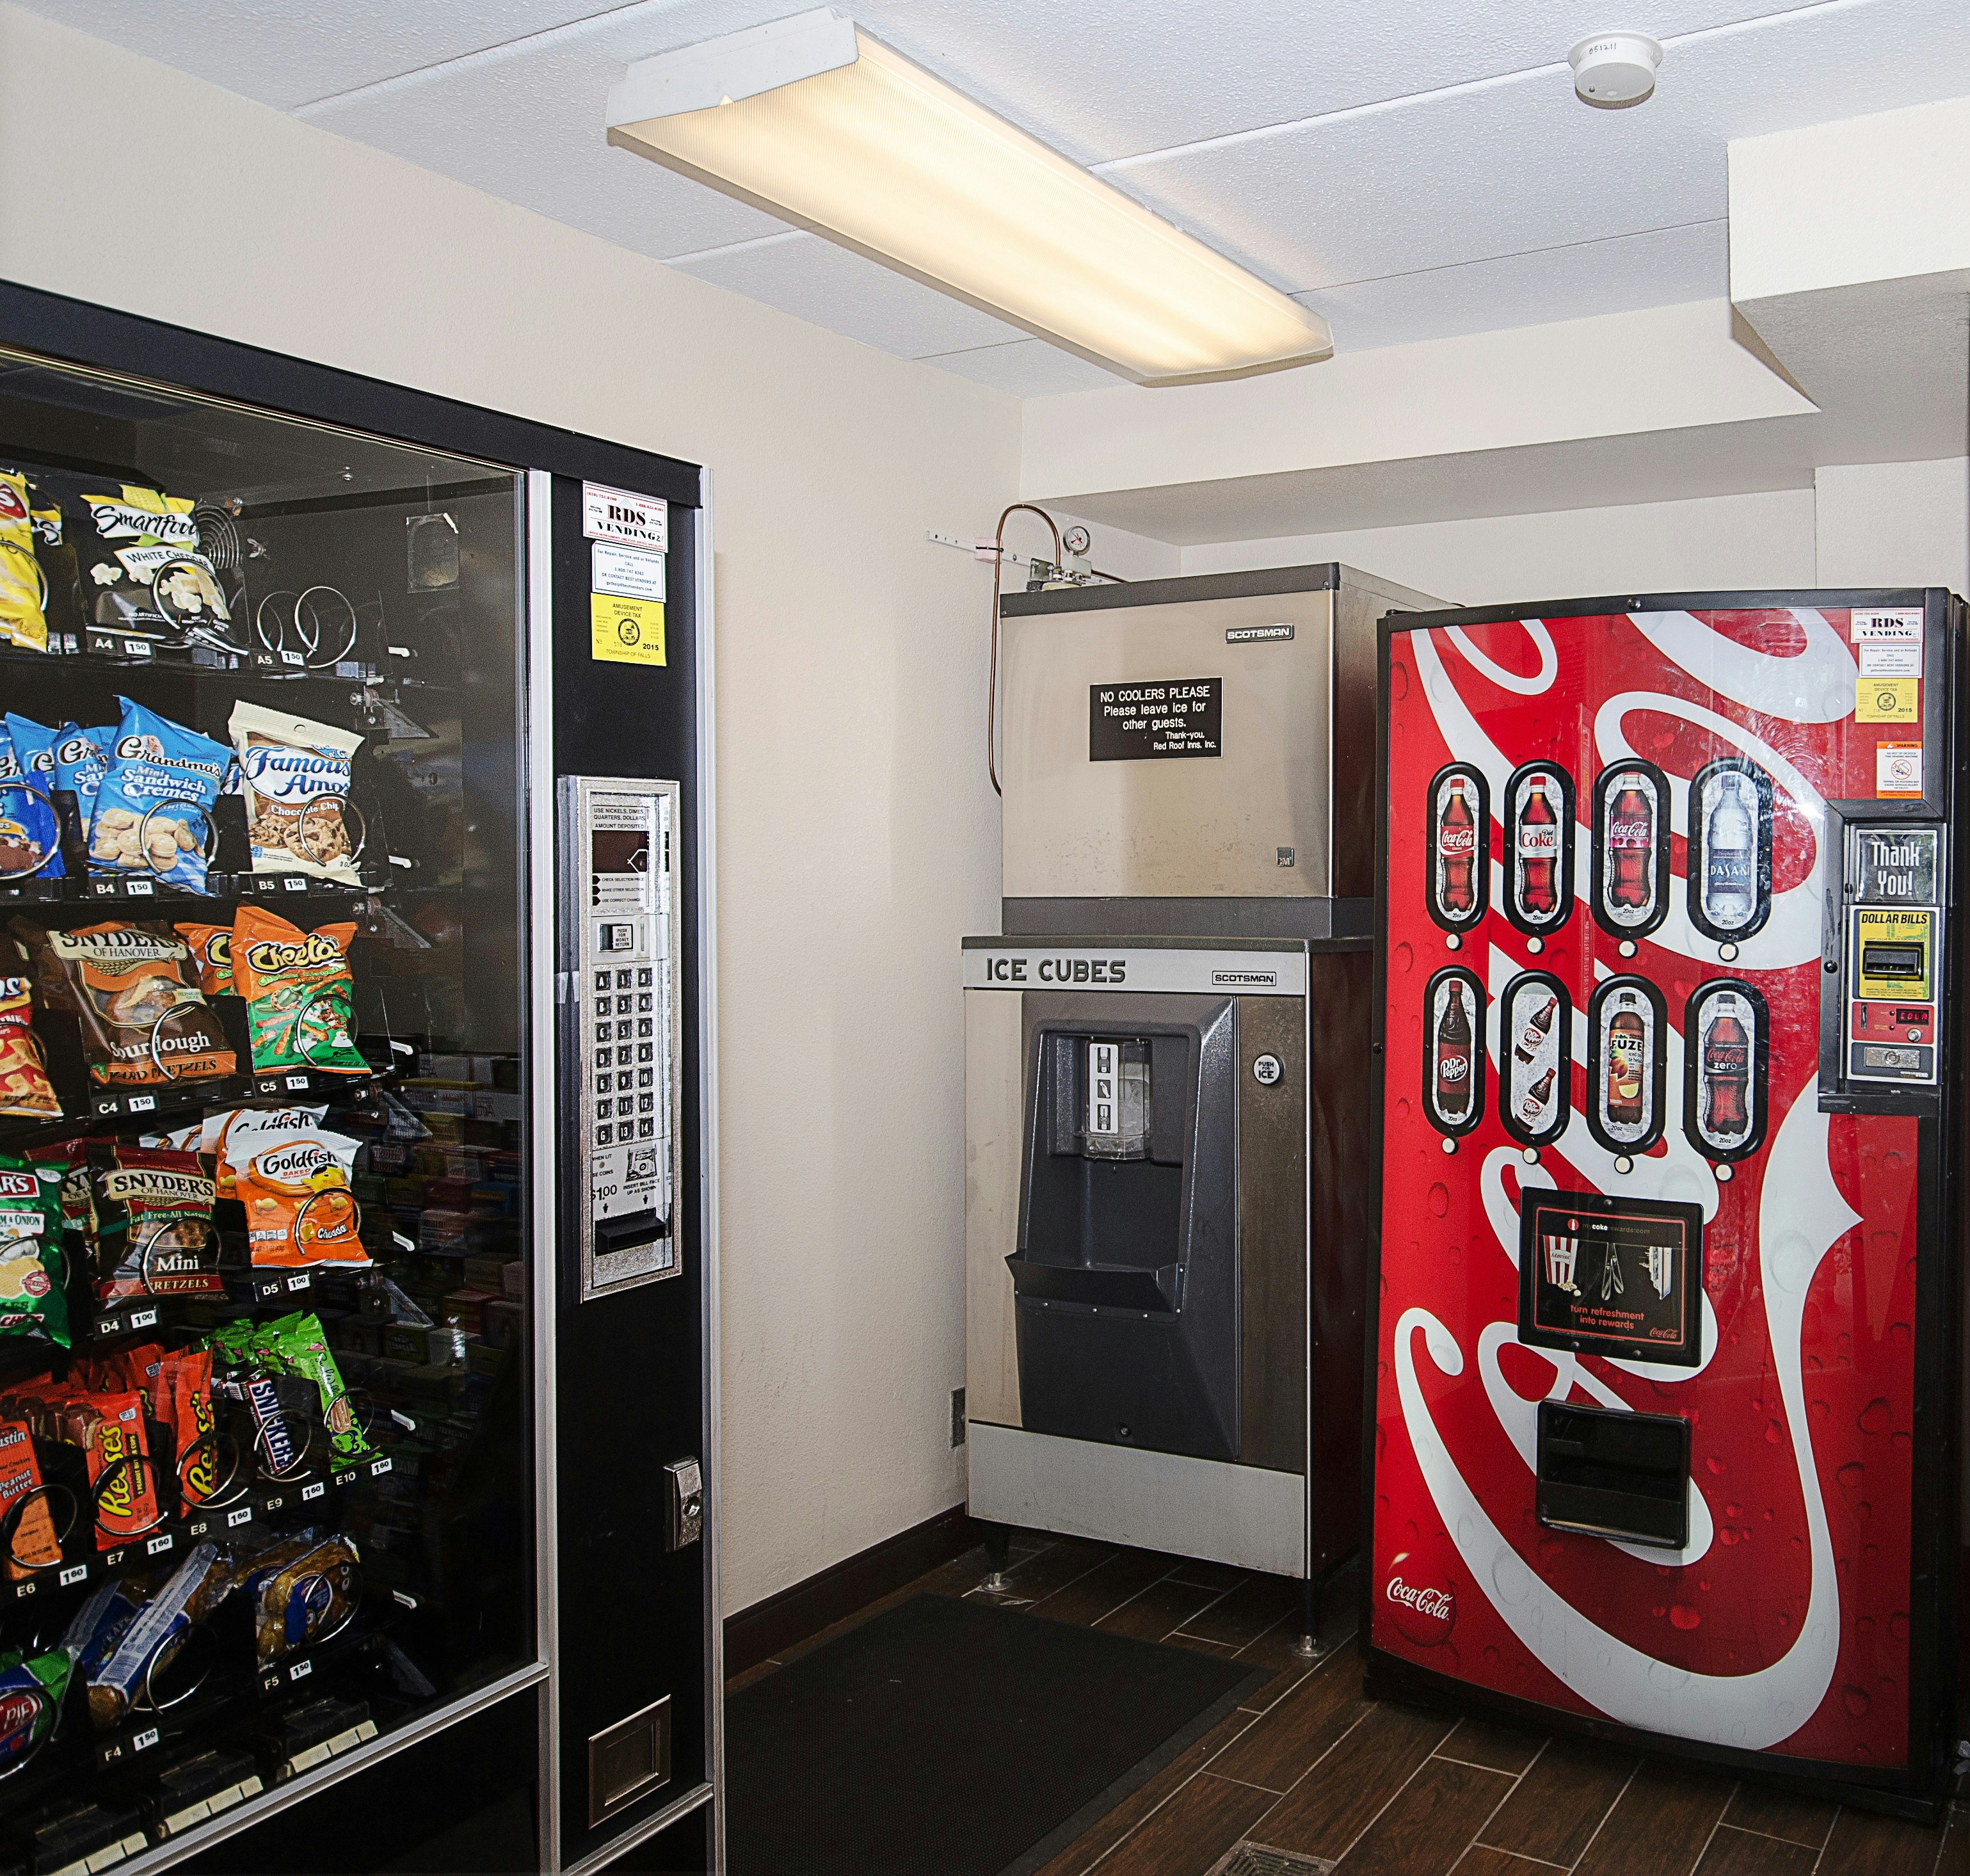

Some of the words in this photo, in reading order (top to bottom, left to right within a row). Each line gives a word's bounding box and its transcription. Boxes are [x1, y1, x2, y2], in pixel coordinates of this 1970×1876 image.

[607, 504, 646, 526] RDS
[597, 521, 655, 540] VENDING
[126, 551, 164, 564] WHITE
[612, 603, 643, 612] AMUSEMENT
[1871, 618, 1903, 628] RDS
[1226, 627, 1290, 640] SCOTSMAN
[95, 638, 114, 650] A4
[605, 648, 630, 657] TOWNSHIP
[257, 654, 273, 665] A5
[1100, 691, 1114, 703] NO
[1118, 689, 1165, 702] COOLERS
[1169, 685, 1210, 699] PLEASE
[1104, 705, 1137, 717] Please
[1141, 703, 1168, 715] leave
[1192, 700, 1206, 712] for
[1123, 719, 1147, 730] other
[1151, 718, 1187, 731] guests.
[1165, 730, 1205, 741] Thank-you.
[1153, 742, 1167, 751] Red
[1169, 741, 1185, 750] Roof
[1205, 740, 1217, 749] Inc.
[115, 736, 221, 777] Grandma's
[245, 745, 351, 780] Famous
[136, 765, 164, 777] Mini
[121, 768, 207, 794] Sandwich
[122, 783, 200, 802] Cremes
[1542, 828, 1554, 837] Diet
[1521, 833, 1554, 847] Coke
[1871, 841, 1921, 867] Thank
[1710, 863, 1750, 876] DASANI
[95, 884, 115, 894] B4
[259, 881, 275, 890] B5
[1877, 870, 1913, 895] You!
[1861, 913, 1898, 924] DOLLAR
[1900, 914, 1928, 924] BILLS
[93, 948, 108, 957] OF
[110, 948, 161, 958] HANOVER
[986, 958, 1027, 981] ICE
[1037, 959, 1126, 983] CUBES
[1215, 974, 1274, 985] SCOTSMAN
[1612, 1039, 1643, 1052] FUZE
[1442, 1061, 1468, 1079] Pepper
[1450, 1059, 1461, 1069] Dr
[1714, 1062, 1738, 1070] zero
[641, 1073, 648, 1084] 10
[1258, 1070, 1274, 1079] ICE
[260, 1082, 276, 1092] C5
[99, 1103, 118, 1114] C4
[620, 1101, 628, 1112] 11
[641, 1098, 648, 1109] 12
[620, 1126, 628, 1137] 13
[641, 1123, 648, 1134] 14
[263, 1148, 338, 1175] Goldfish
[282, 1168, 311, 1176] BAKED
[113, 1173, 214, 1197] SNYDER'S
[623, 1182, 639, 1191] INSERT
[141, 1185, 154, 1194] OF
[155, 1188, 198, 1199] HANOVER
[15, 1214, 40, 1226] ONION
[129, 1214, 144, 1224] Fat
[156, 1255, 200, 1272] Mini
[262, 1284, 278, 1295] D5
[1570, 1304, 1588, 1314] turn
[1590, 1307, 1644, 1320] refreshment
[101, 1323, 120, 1334] D4
[1580, 1316, 1596, 1324] into
[1599, 1319, 1635, 1329] rewards
[336, 1472, 356, 1486] E10
[2, 1478, 33, 1500] Butter
[267, 1498, 283, 1511] E9
[191, 1523, 207, 1535] E8
[107, 1551, 124, 1566] E7
[17, 1583, 36, 1598] E6
[1386, 1576, 1453, 1620] Coca-Cola
[264, 1676, 280, 1690] F5
[104, 1746, 122, 1762] F4
